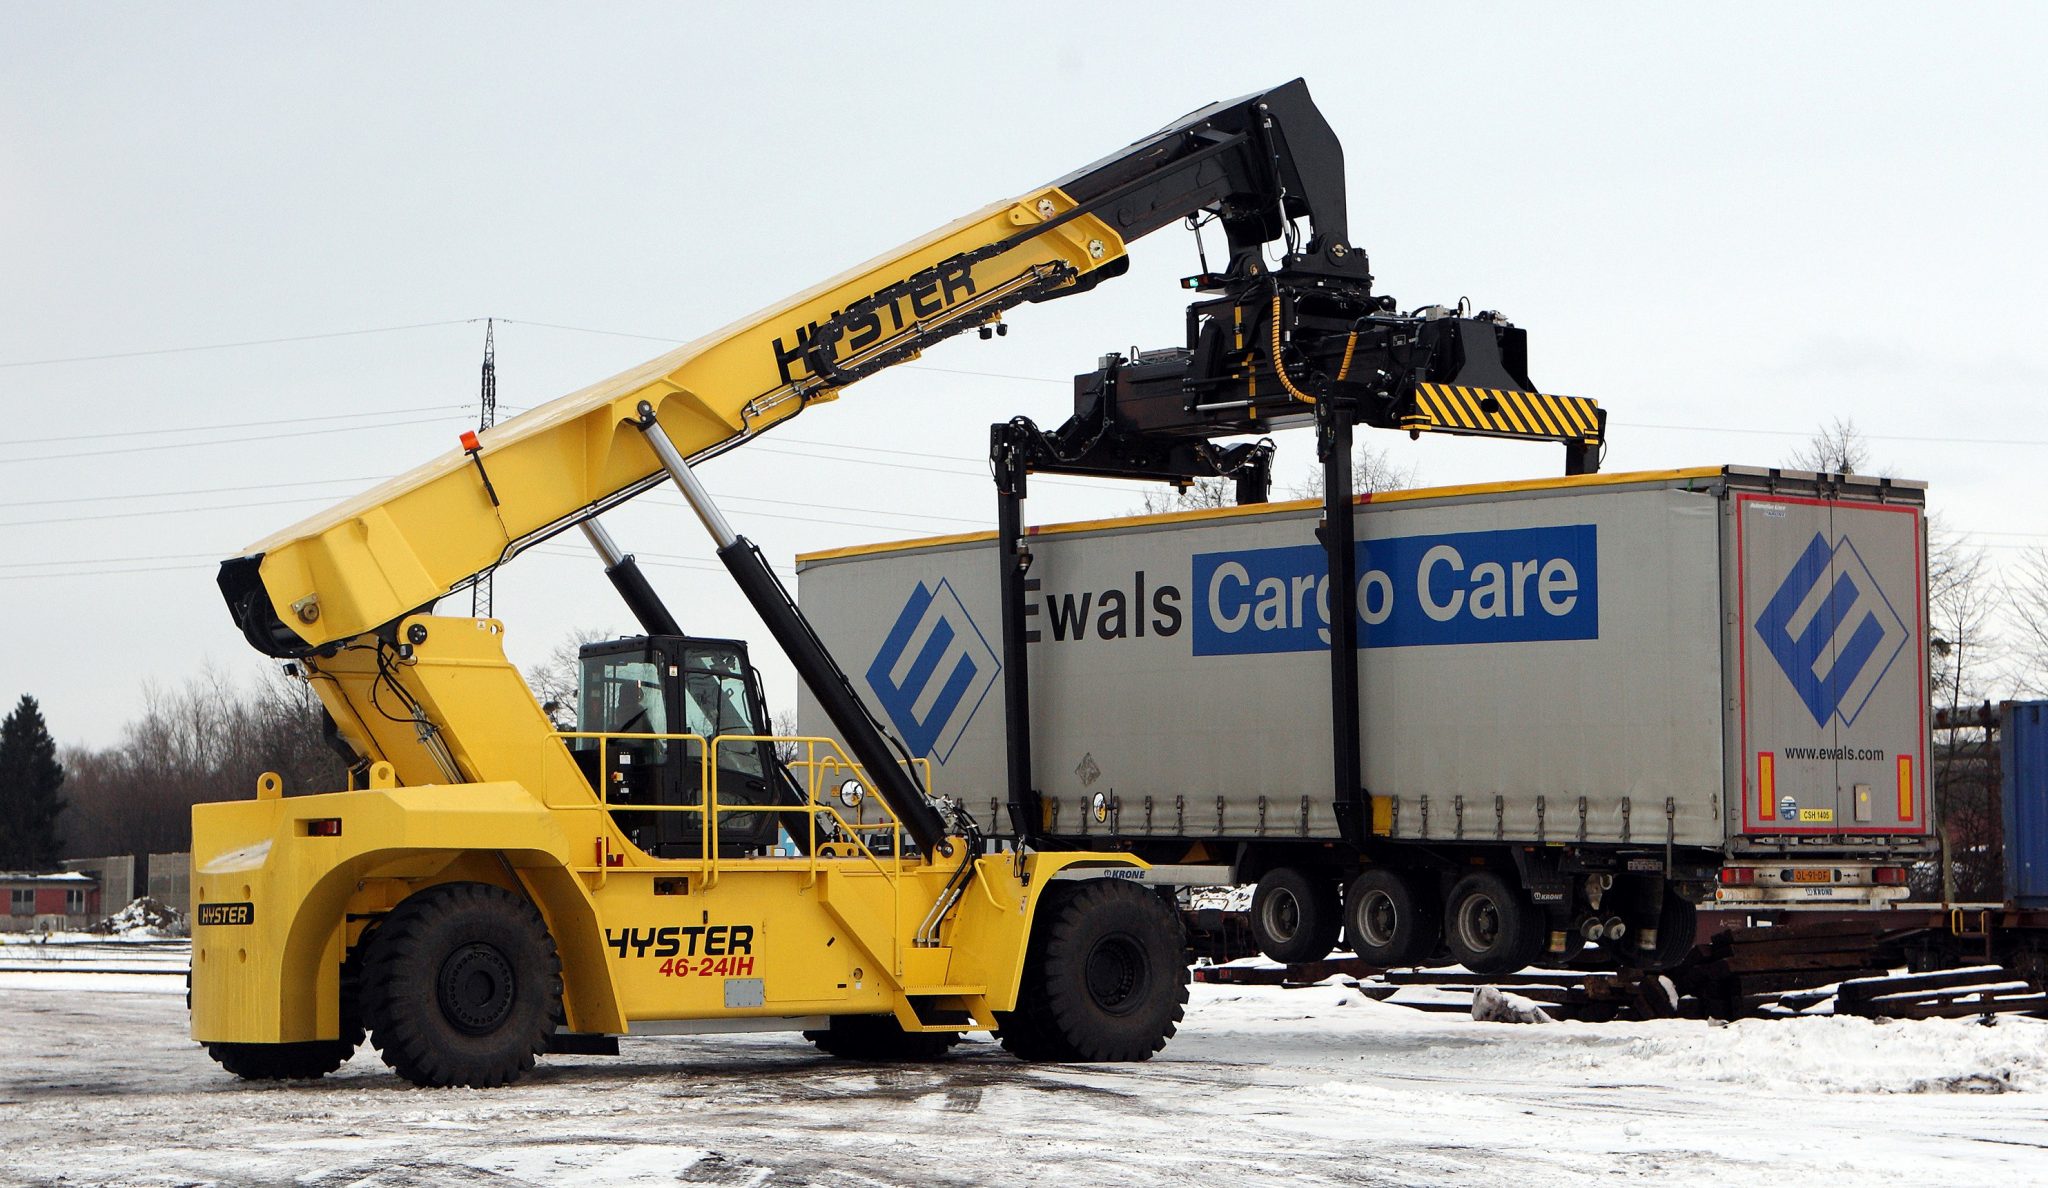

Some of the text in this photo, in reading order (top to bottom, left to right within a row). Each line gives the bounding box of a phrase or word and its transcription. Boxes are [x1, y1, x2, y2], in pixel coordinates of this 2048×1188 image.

[1417, 545, 1578, 621] Care
[1785, 745, 1884, 761] www.ewals.com
[1111, 870, 1146, 879] KRONE
[202, 906, 248, 923] HYSTER
[605, 925, 754, 958] HYSTER
[658, 957, 755, 977] 46-24IH
